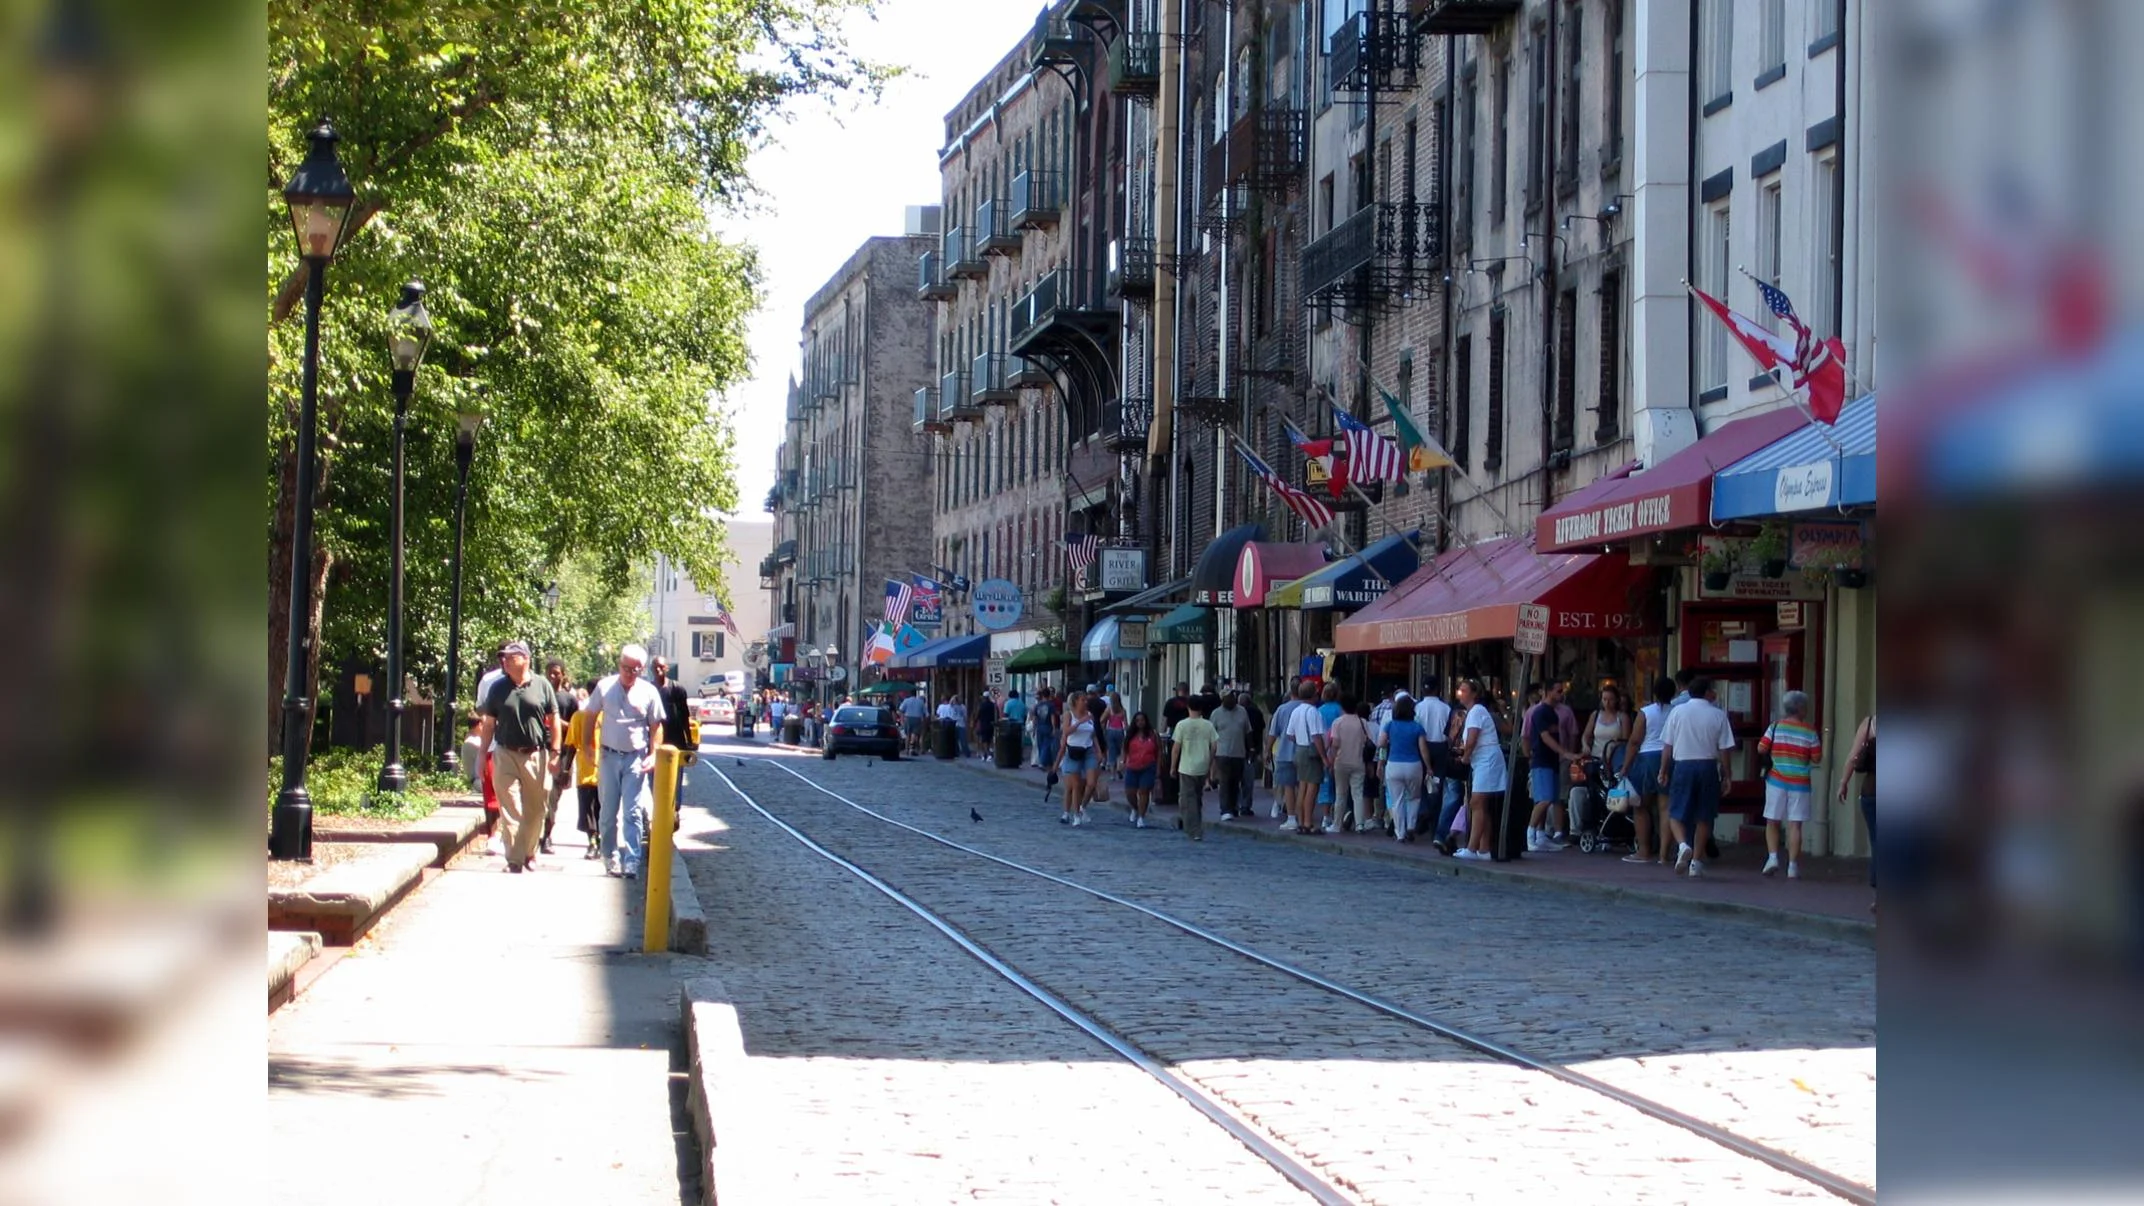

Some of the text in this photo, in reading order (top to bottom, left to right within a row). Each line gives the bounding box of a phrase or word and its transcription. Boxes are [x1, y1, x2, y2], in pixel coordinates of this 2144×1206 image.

[1555, 494, 1671, 544] RIVERBOAT TICKET OFFICE
[1798, 529, 1861, 545] OLYMPIA
[1109, 560, 1136, 569] RIVER
[1109, 577, 1135, 587] GRILL
[1362, 579, 1390, 590] THE
[1734, 588, 1791, 596] INFORMATION
[1527, 609, 1539, 619] NO
[1519, 618, 1545, 631] PARKING
[1559, 612, 1643, 629] EST. 1973
[989, 672, 1002, 683] 15
